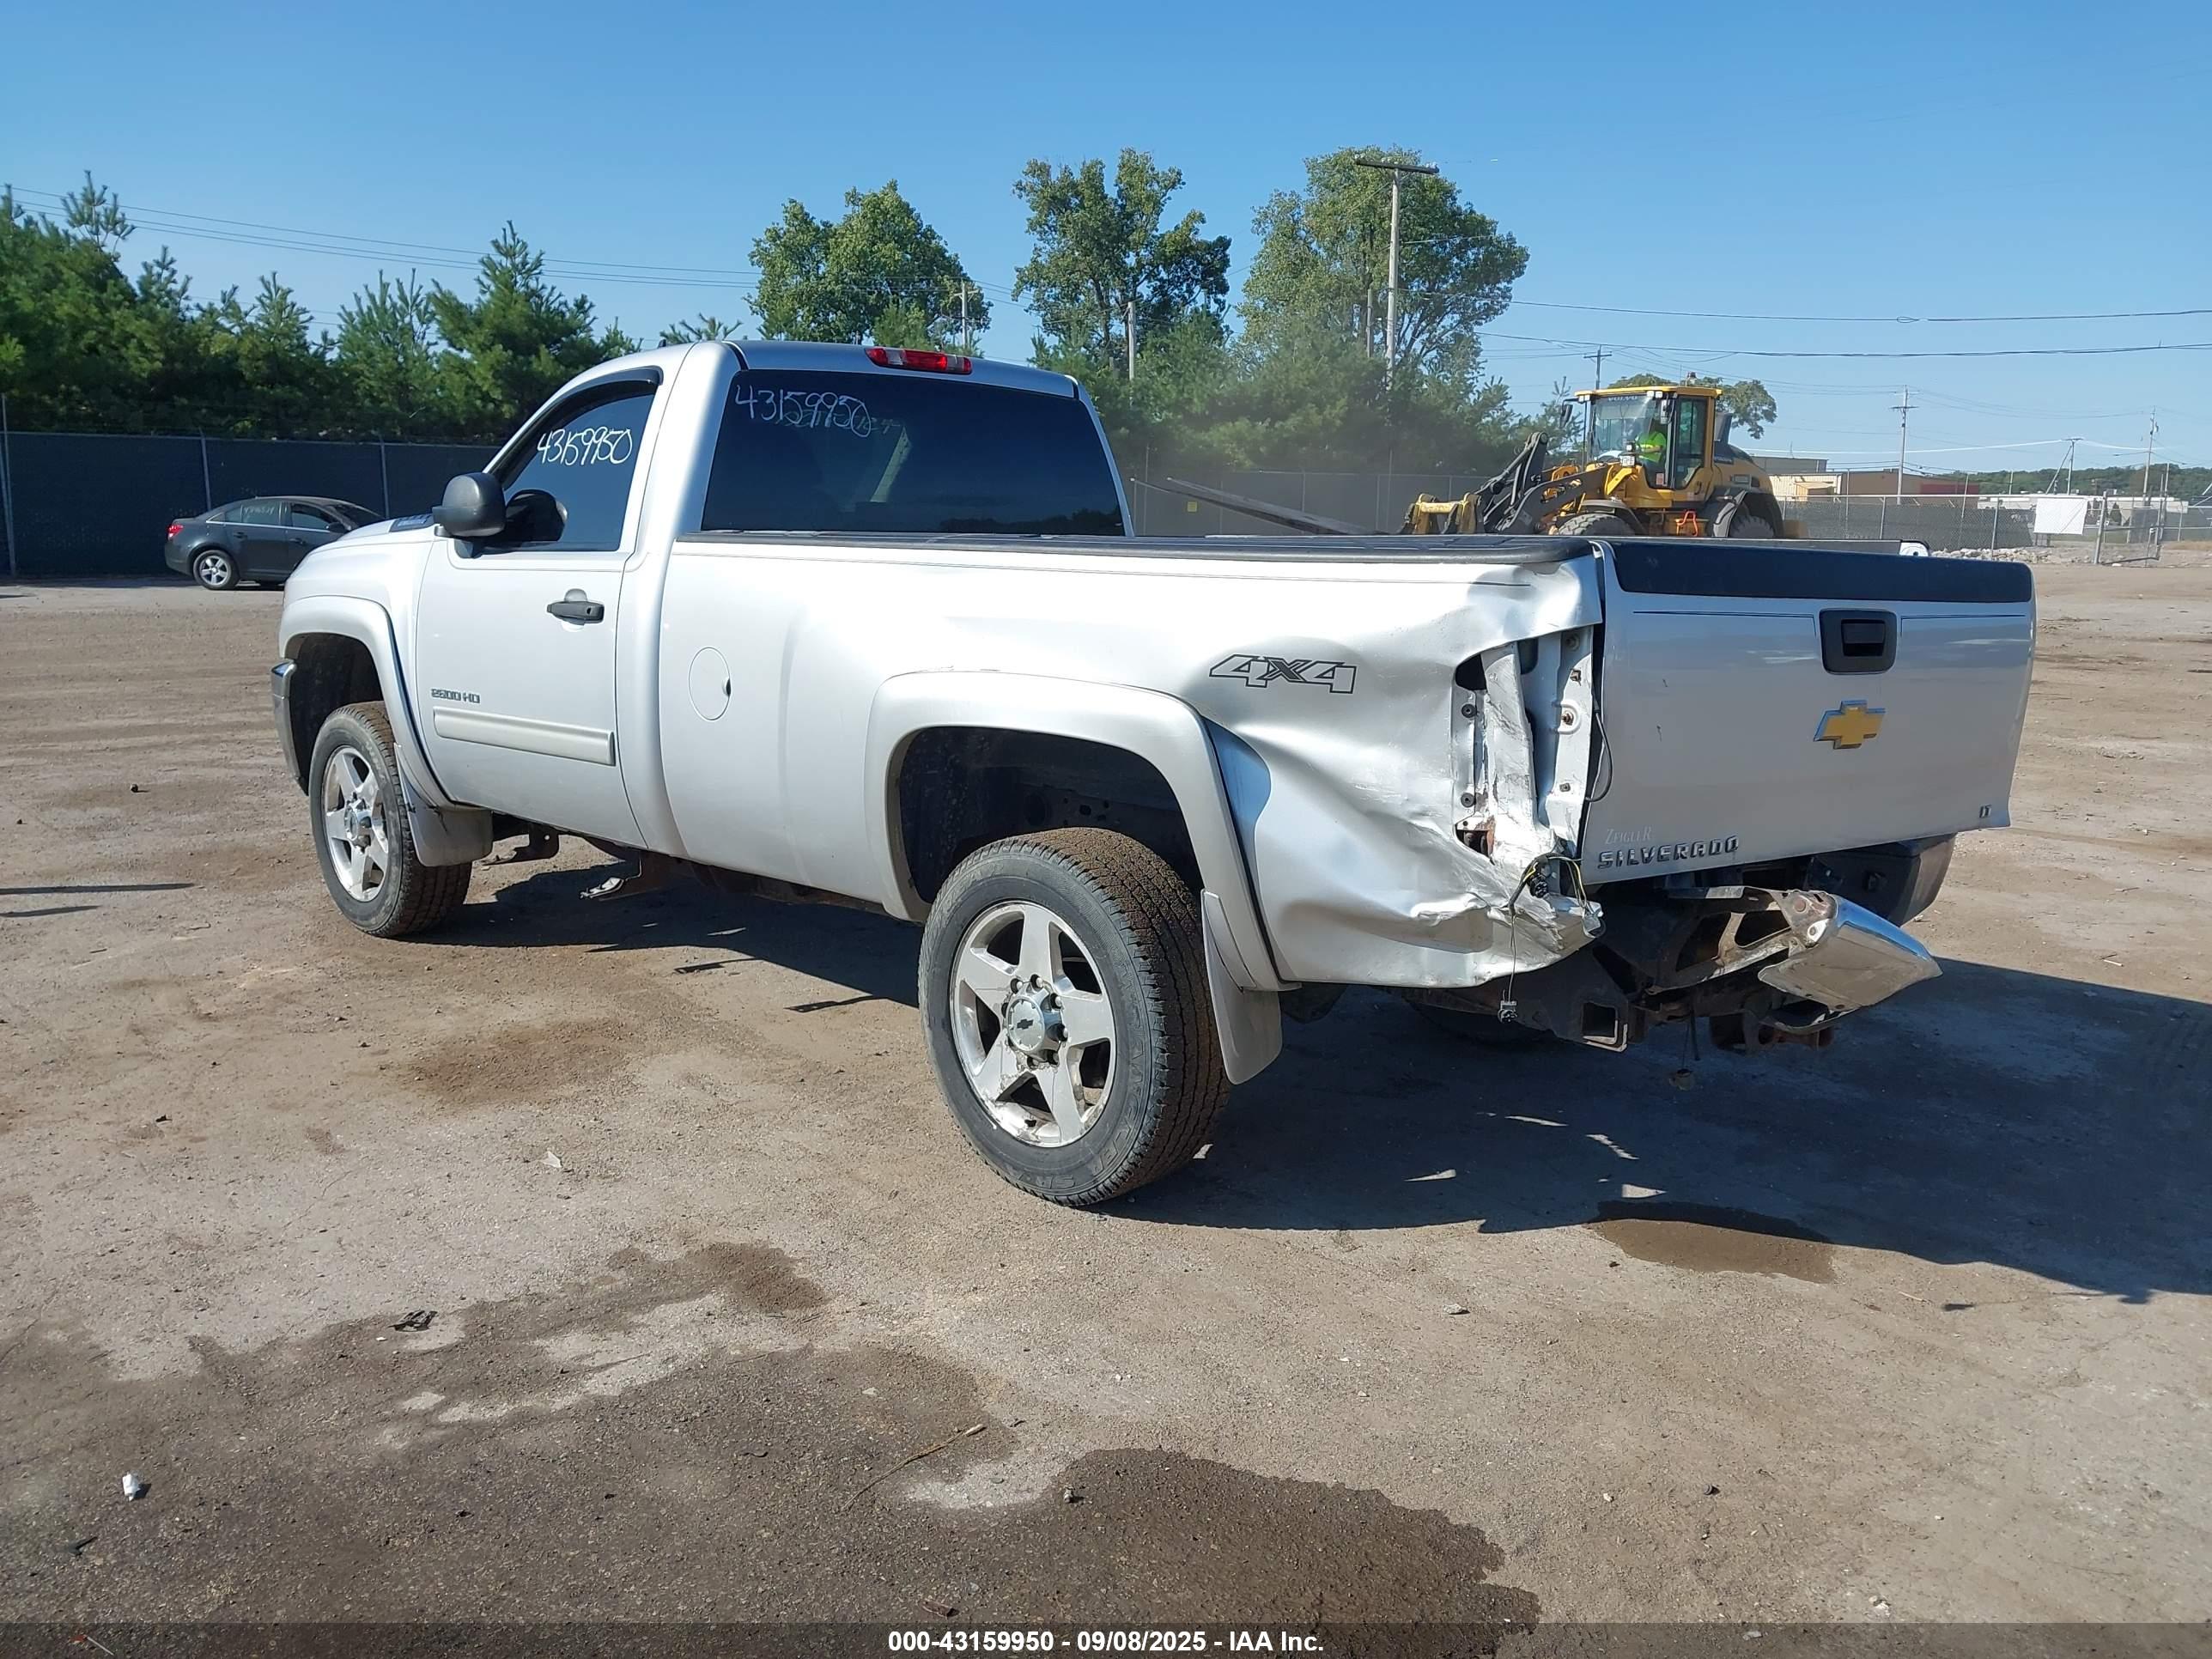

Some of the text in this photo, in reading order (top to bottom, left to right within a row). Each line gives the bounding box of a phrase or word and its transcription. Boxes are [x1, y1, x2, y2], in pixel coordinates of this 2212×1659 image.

[735, 385, 871, 437] 43159950
[536, 426, 633, 466] 43159950
[431, 688, 481, 704] 2500 HD
[1597, 836, 1740, 869] SILVERADO
